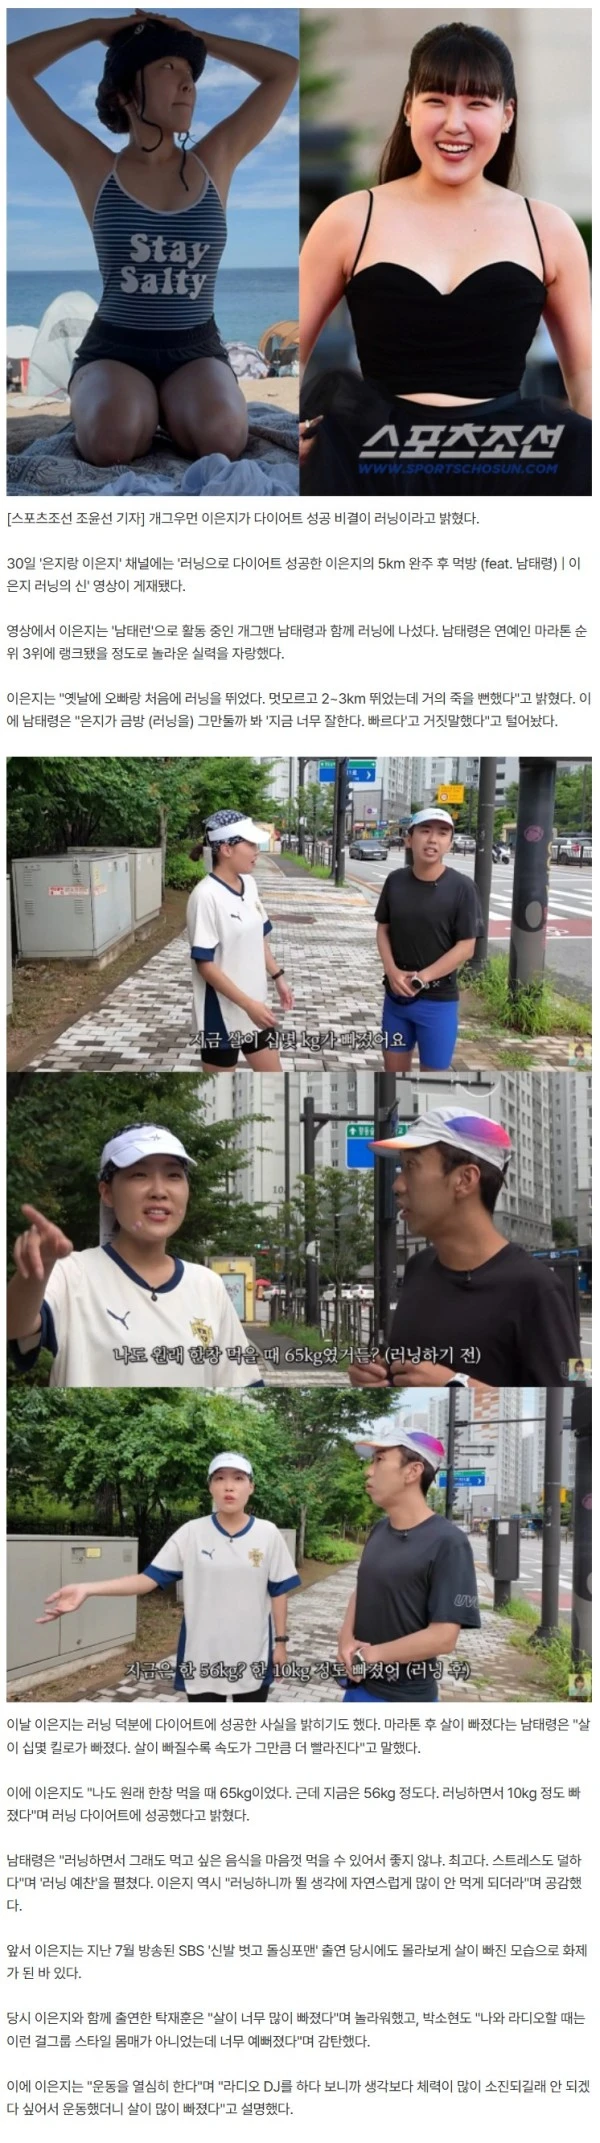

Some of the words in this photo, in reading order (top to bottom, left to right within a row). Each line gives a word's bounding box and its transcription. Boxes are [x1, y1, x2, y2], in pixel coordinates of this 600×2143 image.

[131, 234, 210, 268] Stay
[120, 266, 206, 300] Salty
[8, 512, 72, 527] [스포츠조선
[76, 512, 112, 525] 조윤선
[117, 512, 144, 527] 기자]
[149, 512, 197, 525] 개그우먼
[202, 512, 251, 525] 이은지가
[255, 512, 303, 525] 다이어트
[307, 512, 331, 525] 성공
[335, 512, 370, 525] 비결이
[375, 512, 436, 525] 러닝이라고
[440, 512, 479, 525] 밝혔다.
[7, 580, 30, 592] 은지
[35, 580, 70, 592] 러닝의
[75, 580, 89, 592] 신'
[93, 580, 129, 592] 영상이
[134, 580, 185, 592] 게재됐다.
[7, 625, 55, 637] 영상에서
[60, 625, 108, 637] 이은지는
[112, 625, 177, 637] '남태런'으로
[182, 625, 206, 637] 활동
[210, 625, 233, 637] 중인
[238, 625, 274, 637] 개그맨
[278, 625, 327, 638] 남태령과
[331, 624, 354, 637] 함께
[359, 625, 394, 637] 러닝에
[399, 625, 438, 637] 나섰다.
[443, 625, 491, 638] 남태령은
[495, 625, 530, 637] 연예인
[535, 625, 571, 637] 마라톤
[575, 625, 587, 637] 순
[7, 647, 18, 660] 위
[23, 647, 55, 660] 3위에
[59, 647, 107, 660] 랭크됐을
[112, 647, 148, 660] 정도로
[152, 647, 188, 660] 놀라운
[193, 647, 228, 660] 실력을
[232, 647, 284, 660] 자랑했다.
[7, 715, 18, 727] 에
[23, 715, 71, 728] 남태령은
[75, 715, 117, 727] "은지가
[121, 715, 145, 727] 금방
[149, 715, 193, 729] (러닝을)
[198, 715, 246, 727] 그만둘까
[249, 715, 262, 727] 봐
[266, 715, 293, 727] '지금
[297, 715, 321, 727] 너무
[325, 715, 364, 727] 잘한다.
[368, 715, 419, 727] 빠르다'고
[424, 715, 502, 727] 거짓말했다"고
[506, 715, 557, 727] 털어놨다.
[7, 1718, 31, 1731] 이날
[35, 1718, 83, 1731] 이은지는
[88, 1718, 110, 1731] 러닝
[116, 1718, 151, 1731] 덕분에
[156, 1718, 216, 1731] 다이어트에
[221, 1718, 256, 1731] 성공한
[261, 1718, 296, 1731] 사실을
[301, 1718, 349, 1731] 밝히기도
[353, 1718, 380, 1731] 했다.
[385, 1718, 420, 1731] 마라톤
[425, 1718, 436, 1731] 후
[441, 1718, 463, 1731] 살이
[468, 1718, 517, 1731] 빠졌다는
[521, 1718, 569, 1731] 남태령은
[573, 1718, 590, 1731] "살
[7, 1742, 18, 1754] 이
[23, 1742, 46, 1754] 십몇
[51, 1742, 87, 1754] 킬로가
[91, 1742, 130, 1754] 빠졌다.
[135, 1742, 157, 1754] 살이
[162, 1742, 211, 1754] 빠질수록
[215, 1742, 251, 1754] 속도가
[255, 1742, 291, 1754] 그만큼
[296, 1742, 306, 1754] 더
[311, 1742, 377, 1754] 빨라진다"고
[381, 1742, 420, 1754] 말했다.
[7, 1809, 48, 1822] 졌다"며
[53, 1809, 75, 1822] 러닝
[81, 1809, 140, 1822] 다이어트에
[145, 1809, 206, 1822] 성공했다고
[210, 1809, 249, 1822] 밝혔다.
[7, 1877, 35, 1889] 다"며
[40, 1877, 66, 1889] '러닝
[71, 1877, 109, 1889] 예찬'을
[114, 1877, 153, 1889] 펼쳤다.
[157, 1877, 192, 1889] 이은지
[198, 1877, 220, 1889] 역시
[226, 1877, 291, 1889] "러닝하니까
[296, 1877, 306, 1889] 뛸
[311, 1877, 347, 1889] 생각에
[351, 1877, 411, 1889] 자연스럽게
[416, 1877, 439, 1889] 많이
[444, 1877, 456, 1889] 안
[460, 1877, 483, 1889] 먹게
[488, 1877, 540, 1889] 되더라"며
[545, 1877, 582, 1889] 공감했
[7, 1899, 22, 1912] 다.
[7, 1967, 19, 1979] 가
[23, 1967, 34, 1979] 된
[39, 1967, 50, 1979] 바
[54, 1967, 81, 1979] 있다.
[7, 2012, 30, 2024] 당시
[35, 2012, 84, 2024] 이은지와
[88, 2012, 111, 2024] 함께
[116, 2012, 152, 2024] 출연한
[156, 2012, 204, 2024] 탁재훈은
[208, 2012, 236, 2024] "살이
[242, 2012, 265, 2024] 너무
[269, 2012, 292, 2024] 많이
[297, 2012, 350, 2024] 빠졌다"며
[355, 2012, 418, 2026] 놀라워했고,
[423, 2012, 471, 2024] 박소현도
[476, 2012, 505, 2024] "나와
[509, 2012, 557, 2024] 라디오할
[561, 2012, 585, 2024] 때는
[7, 2035, 30, 2048] 이런
[35, 2035, 71, 2048] 걸그룹
[75, 2035, 110, 2048] 스타일
[116, 2035, 152, 2048] 몸매가
[156, 2035, 216, 2048] 아니었는데
[221, 2035, 244, 2048] 너무
[248, 2035, 313, 2048] 예뻐졌다"며
[318, 2035, 370, 2048] 감탄했다.
